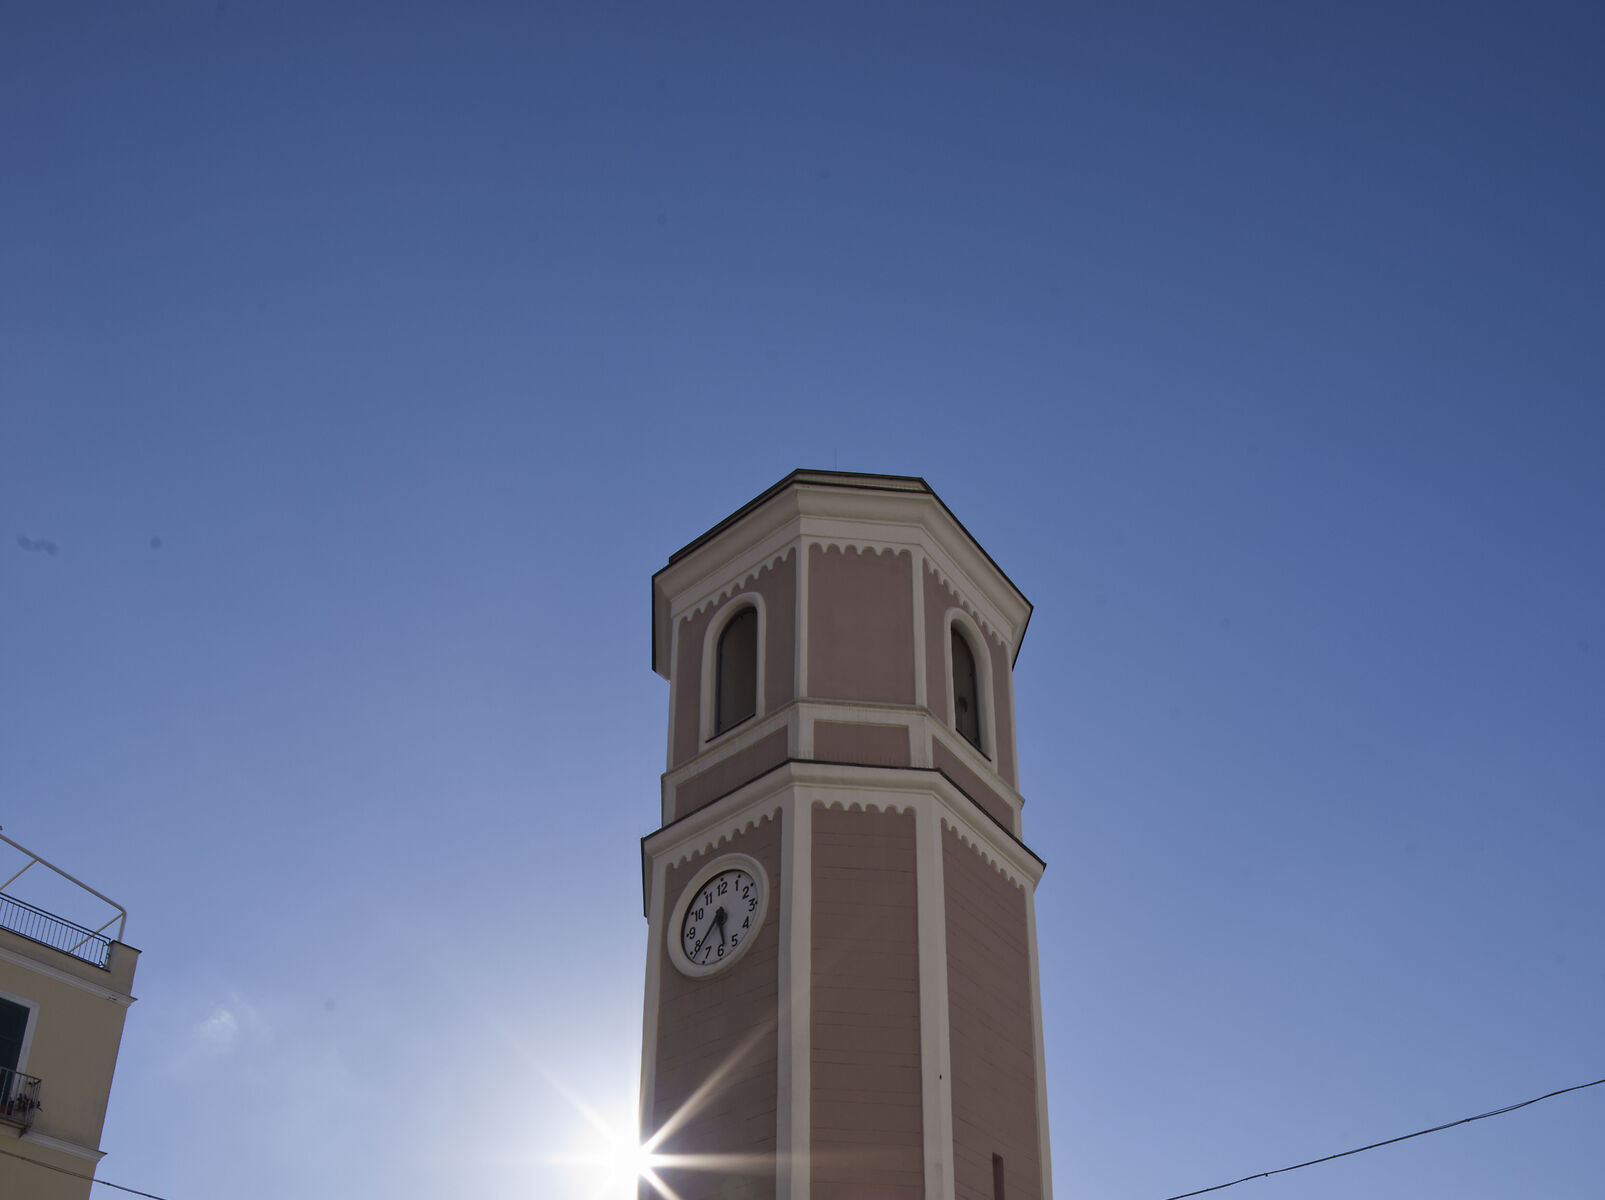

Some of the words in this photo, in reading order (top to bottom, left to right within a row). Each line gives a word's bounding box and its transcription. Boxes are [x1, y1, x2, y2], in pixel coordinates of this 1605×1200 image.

[716, 881, 728, 897] 12
[735, 879, 739, 892] 1
[705, 892, 713, 906] 11
[742, 886, 750, 900] 2
[748, 898, 756, 912] 3
[694, 907, 704, 922] 10
[742, 916, 749, 929] 4
[689, 926, 696, 940] 9
[731, 933, 739, 947] 5
[694, 939, 701, 953] 8
[705, 946, 712, 959] 7
[717, 943, 725, 957] 6
